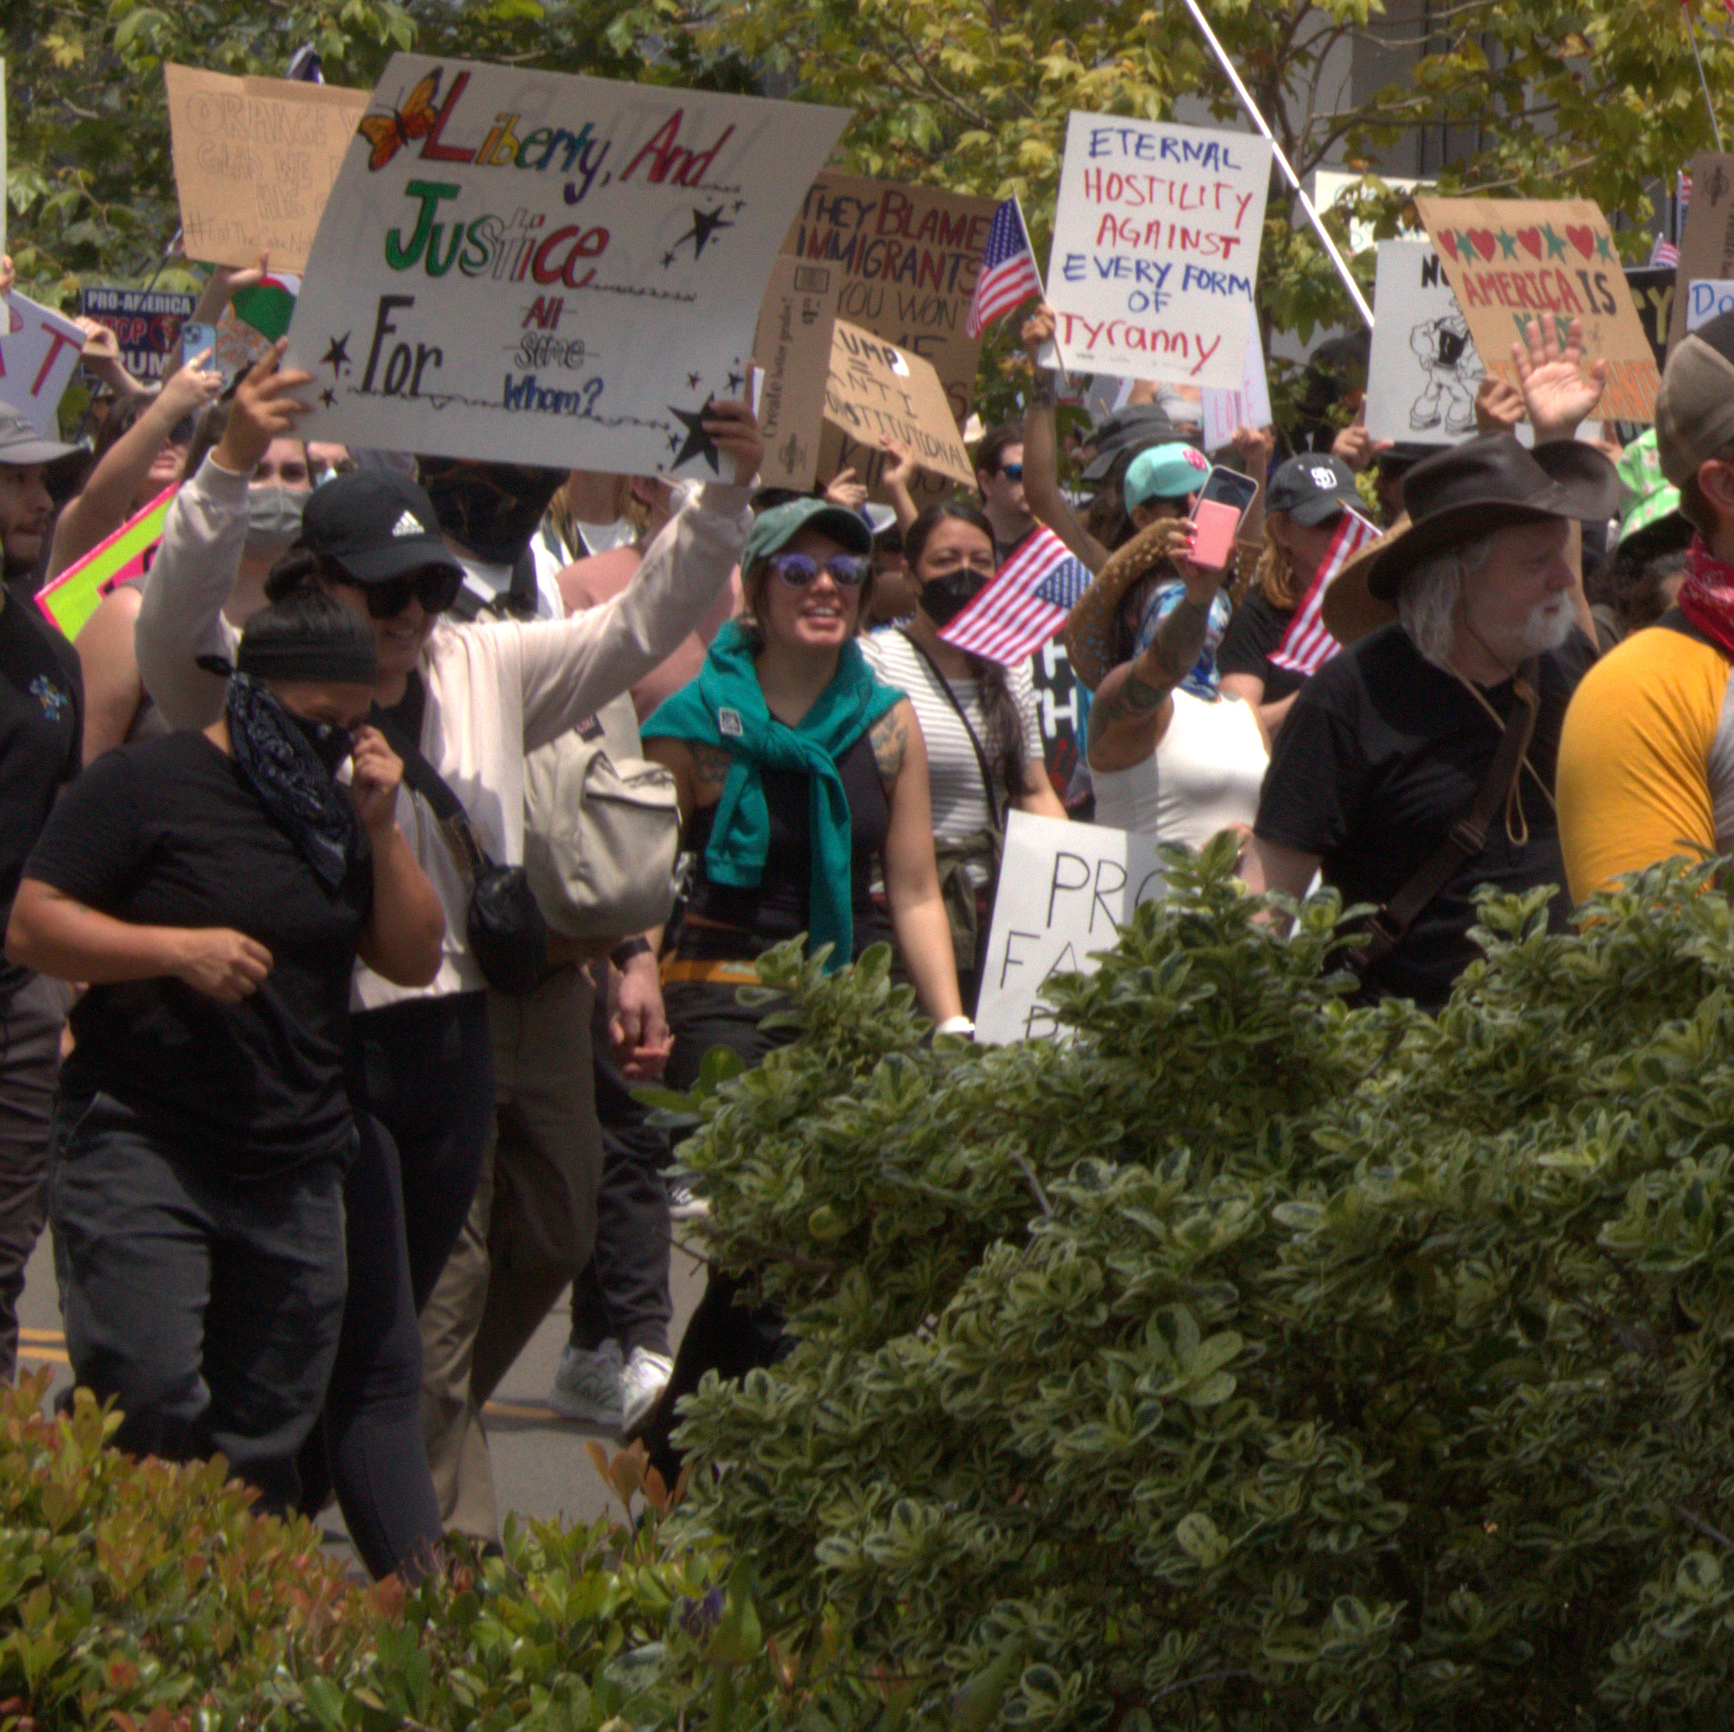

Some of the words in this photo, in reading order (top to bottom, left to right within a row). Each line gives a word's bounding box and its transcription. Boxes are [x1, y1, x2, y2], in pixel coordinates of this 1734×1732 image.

[618, 108, 736, 188] And
[1088, 127, 1242, 170] ETERNAL
[802, 183, 877, 229] THEY
[876, 189, 990, 253] BLAME
[1084, 167, 1253, 230] HOSTILITY
[385, 179, 611, 288] Justice
[796, 224, 985, 296] IMMIGRANTS
[1096, 212, 1241, 260] AGAINST
[837, 280, 885, 320] YOU
[1062, 253, 1173, 289] EVERY
[1182, 263, 1253, 302] FORM
[1127, 290, 1172, 314] OF
[1462, 267, 1586, 315] AMERICA
[1576, 270, 1619, 317] IS
[362, 294, 443, 396] For
[1054, 311, 1222, 377] Tyranny
[504, 372, 606, 417] Whom?
